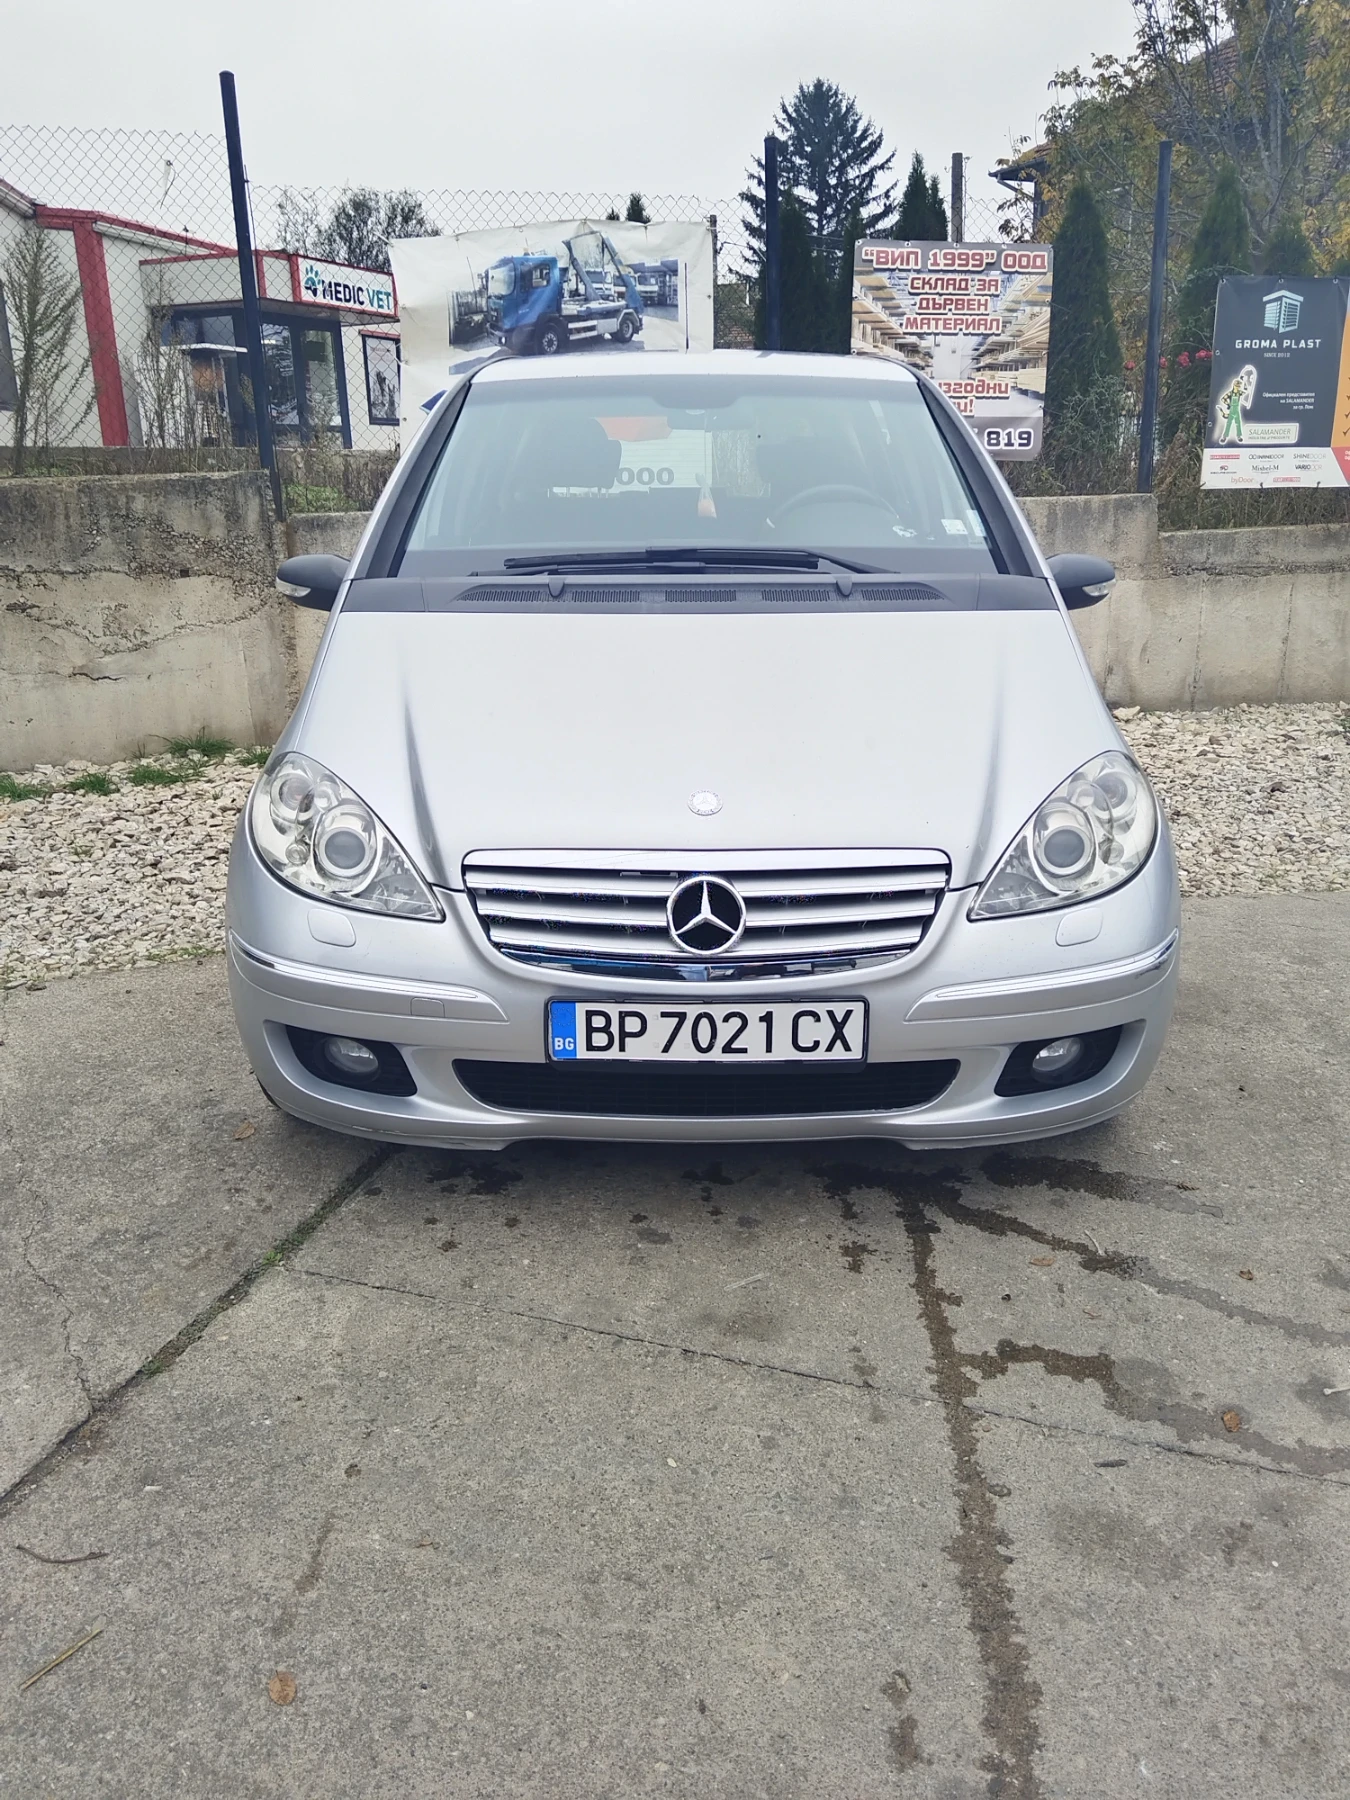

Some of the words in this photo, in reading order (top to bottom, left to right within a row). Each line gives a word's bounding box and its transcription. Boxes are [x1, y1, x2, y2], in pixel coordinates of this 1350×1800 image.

[1003, 252, 1047, 270] ООД
[910, 276, 970, 292] СКЛАД
[975, 278, 999, 293] ЗА
[321, 279, 365, 306] MEDIC
[366, 287, 392, 311] VET
[917, 297, 989, 311] ДЪРВЕН
[904, 317, 1000, 331] МАТЕРИАЛ
[1235, 339, 1278, 349] GROMA
[1283, 339, 1321, 349] PLAST
[985, 430, 1033, 447] 819
[585, 1009, 648, 1053] BP
[660, 1011, 774, 1054] 7021
[791, 1009, 855, 1053] CX
[554, 1038, 575, 1051] BG
